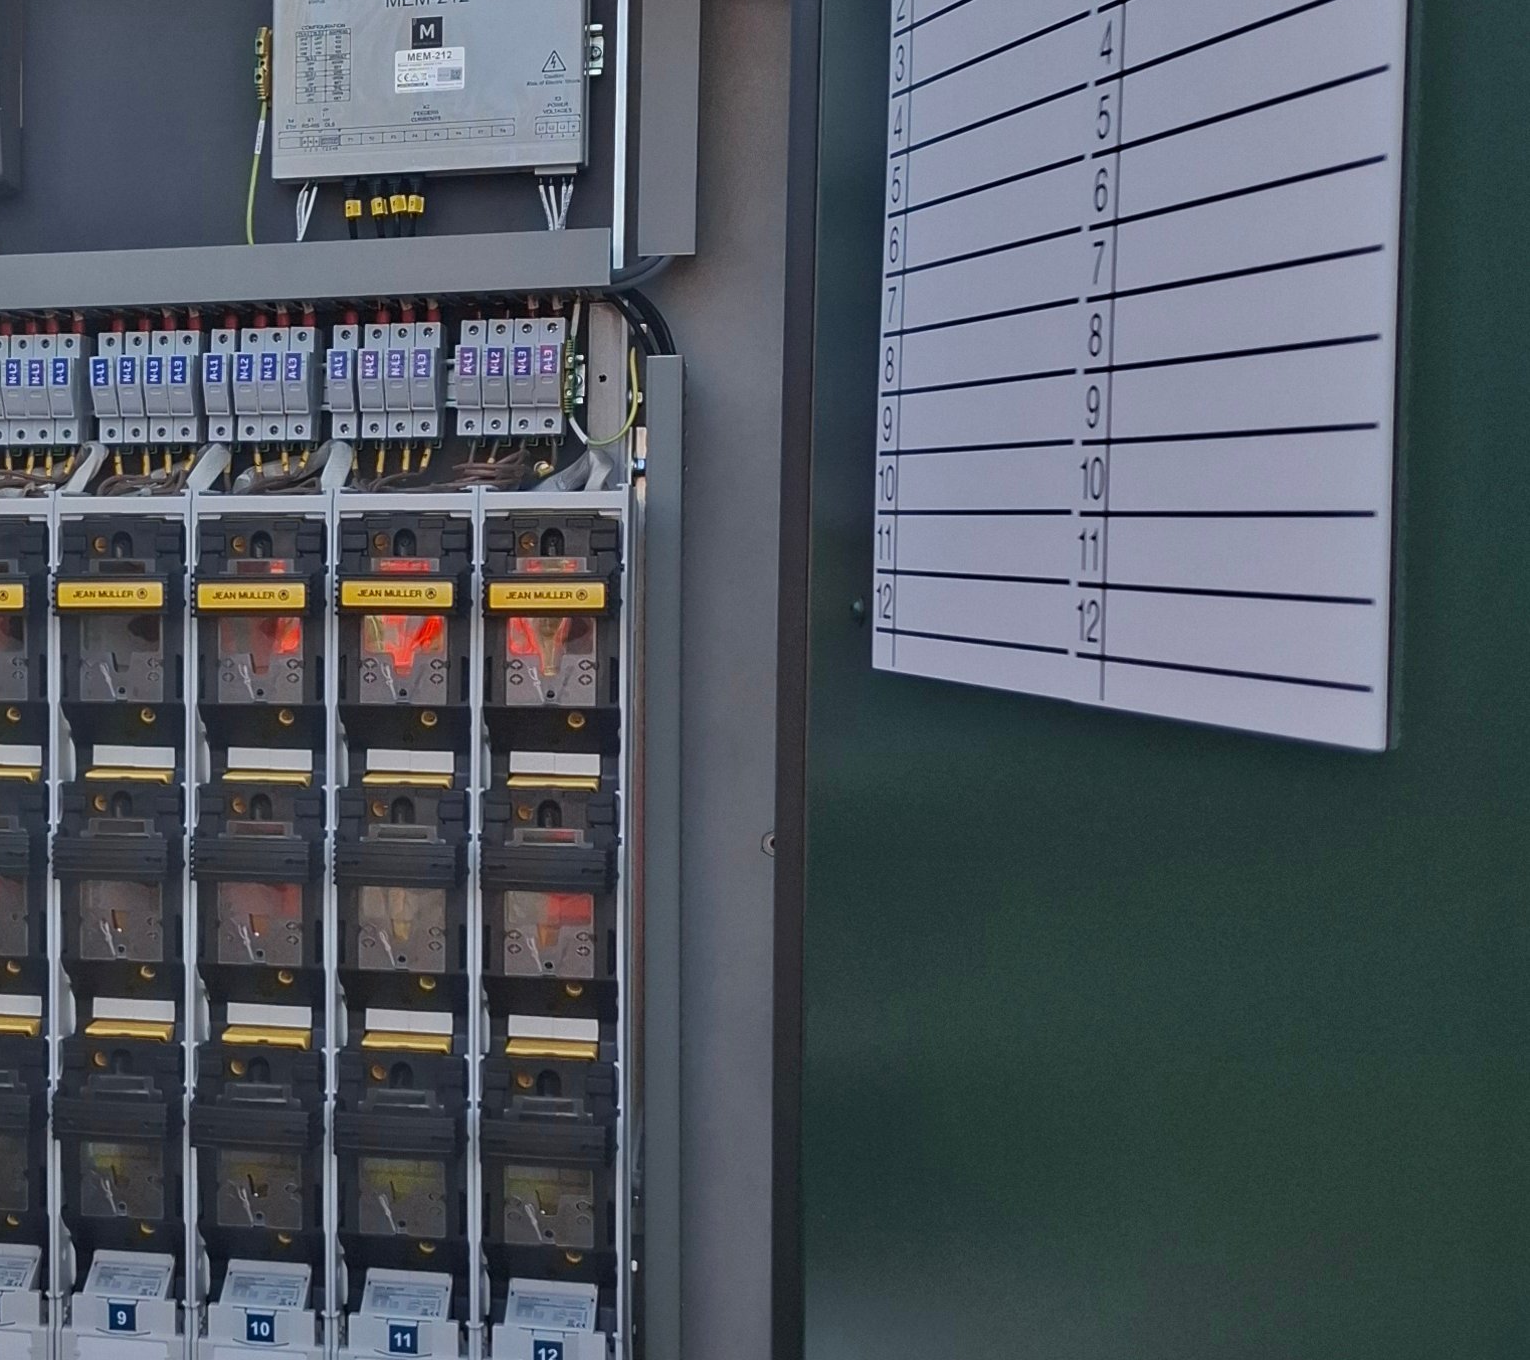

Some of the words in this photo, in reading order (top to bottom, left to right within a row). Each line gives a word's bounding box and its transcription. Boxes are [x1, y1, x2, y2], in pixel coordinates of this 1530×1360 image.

[419, 23, 435, 40] M
[1100, 20, 1113, 64] 4
[407, 50, 453, 62] MEM-212
[895, 44, 905, 82] 3
[893, 105, 902, 141] 4
[1097, 94, 1110, 140] 5
[891, 166, 901, 203] 5
[1094, 168, 1108, 212] 6
[890, 226, 899, 263] 6
[1093, 240, 1105, 284] 7
[888, 286, 897, 323] 7
[1088, 313, 1102, 357] 8
[884, 346, 894, 383] 8
[883, 406, 893, 442] 9
[1086, 385, 1100, 428] 9
[878, 464, 894, 501] 10
[1080, 456, 1104, 500] 10
[877, 523, 891, 560] 11
[1079, 528, 1098, 570] 11
[72, 591, 96, 599] JEAN
[212, 591, 236, 600] JEAN
[357, 589, 381, 598] JEAN
[505, 591, 531, 600] JEAN
[876, 582, 892, 619] 12
[1077, 600, 1100, 643] 12
[117, 1311, 127, 1326] 9
[250, 1321, 270, 1337] 10
[393, 1332, 412, 1348] 11
